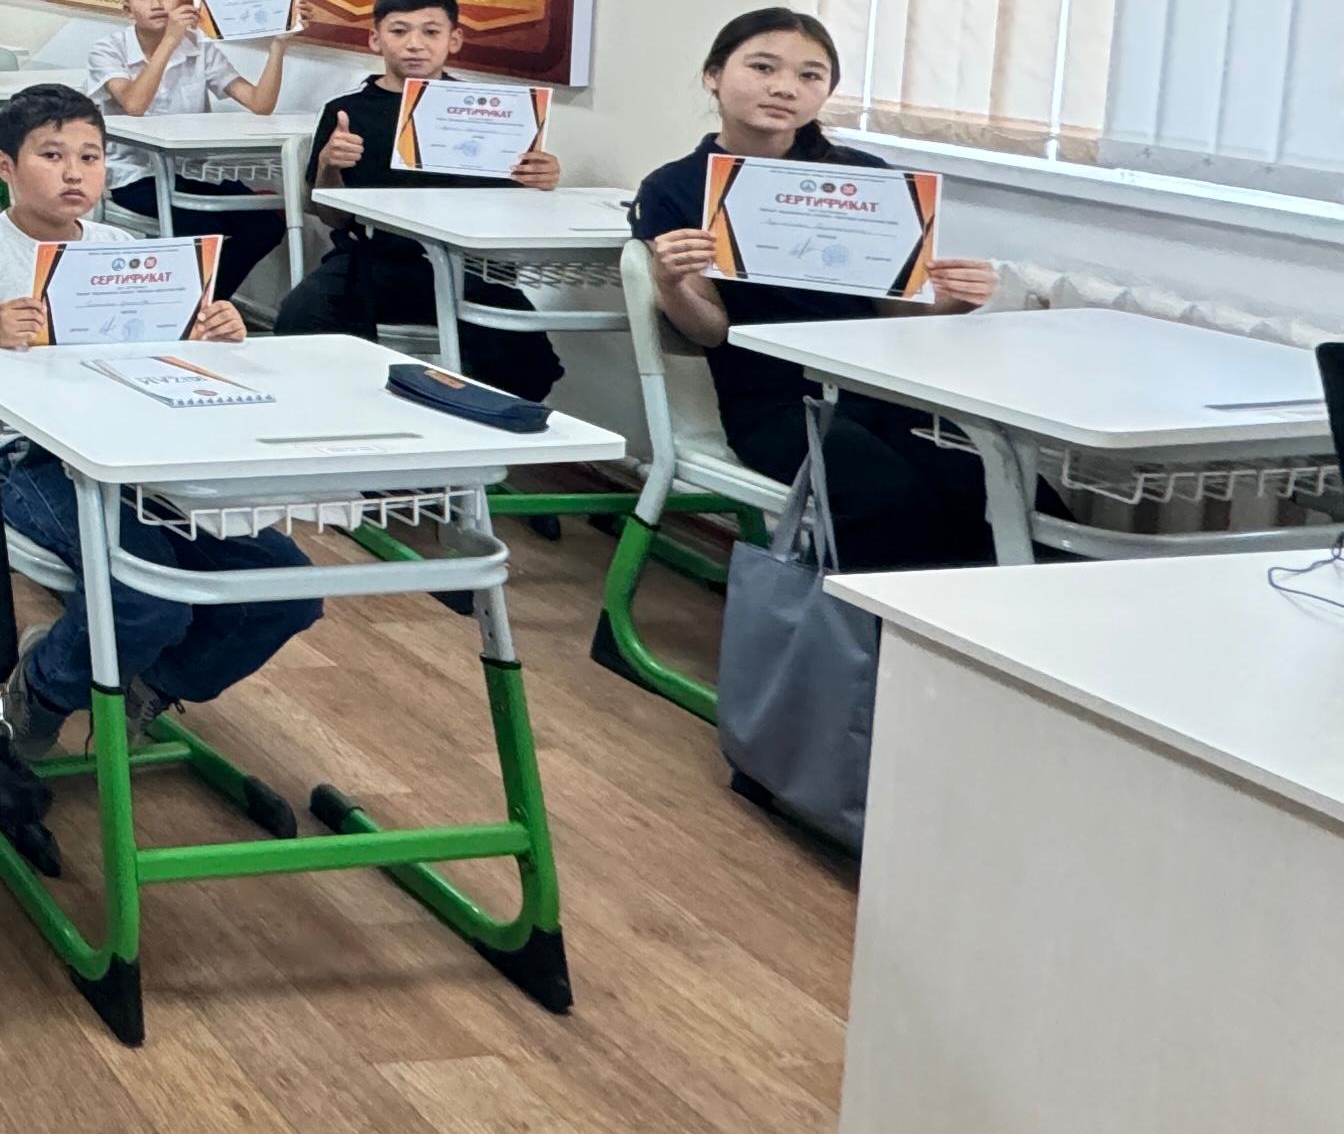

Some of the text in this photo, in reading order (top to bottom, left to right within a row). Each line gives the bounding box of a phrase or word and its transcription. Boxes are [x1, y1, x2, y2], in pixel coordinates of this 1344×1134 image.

[447, 106, 513, 119] СЕРТИФИКАТ
[775, 193, 880, 213] СЕРТИФИКАТ
[90, 271, 173, 286] СЕРТИФИКАТ
